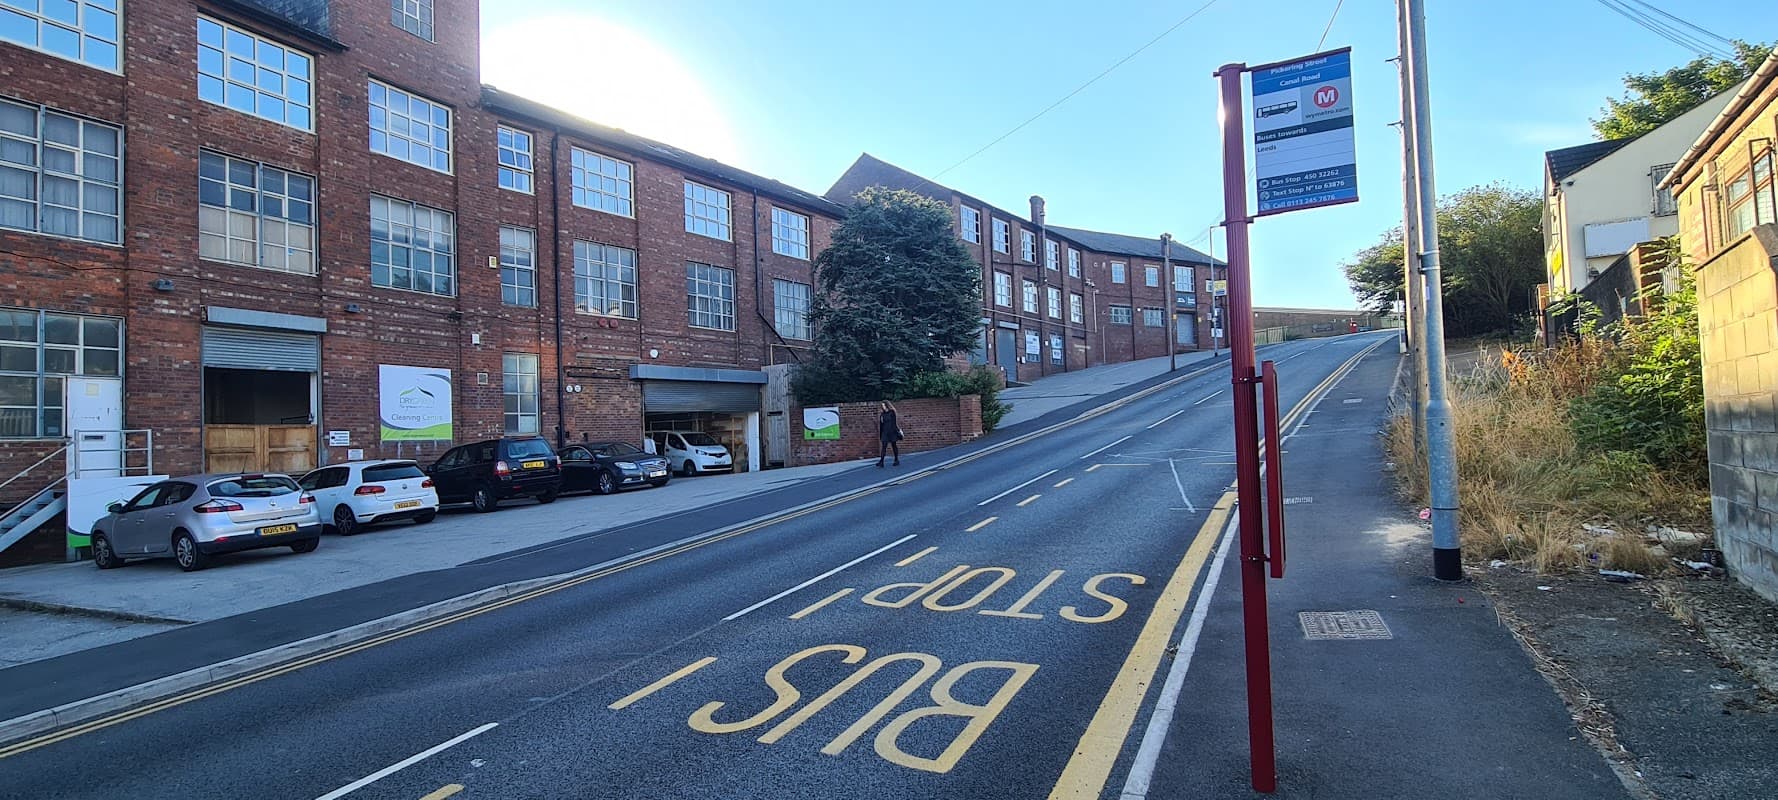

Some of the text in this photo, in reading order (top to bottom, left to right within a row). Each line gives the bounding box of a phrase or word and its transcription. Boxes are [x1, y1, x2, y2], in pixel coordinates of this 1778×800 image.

[1270, 57, 1327, 75] Pickering Street
[1279, 73, 1320, 86] Canal Road
[1317, 90, 1335, 105] M
[1305, 107, 1350, 118] wymetro.com
[1256, 127, 1307, 142] Buses towards
[1257, 144, 1277, 153] Leeds
[1285, 176, 1301, 184] Stop
[1288, 187, 1304, 195] Stop
[391, 413, 421, 423] Cleaning
[861, 566, 1146, 623] STOP
[687, 643, 1041, 774] BUS
